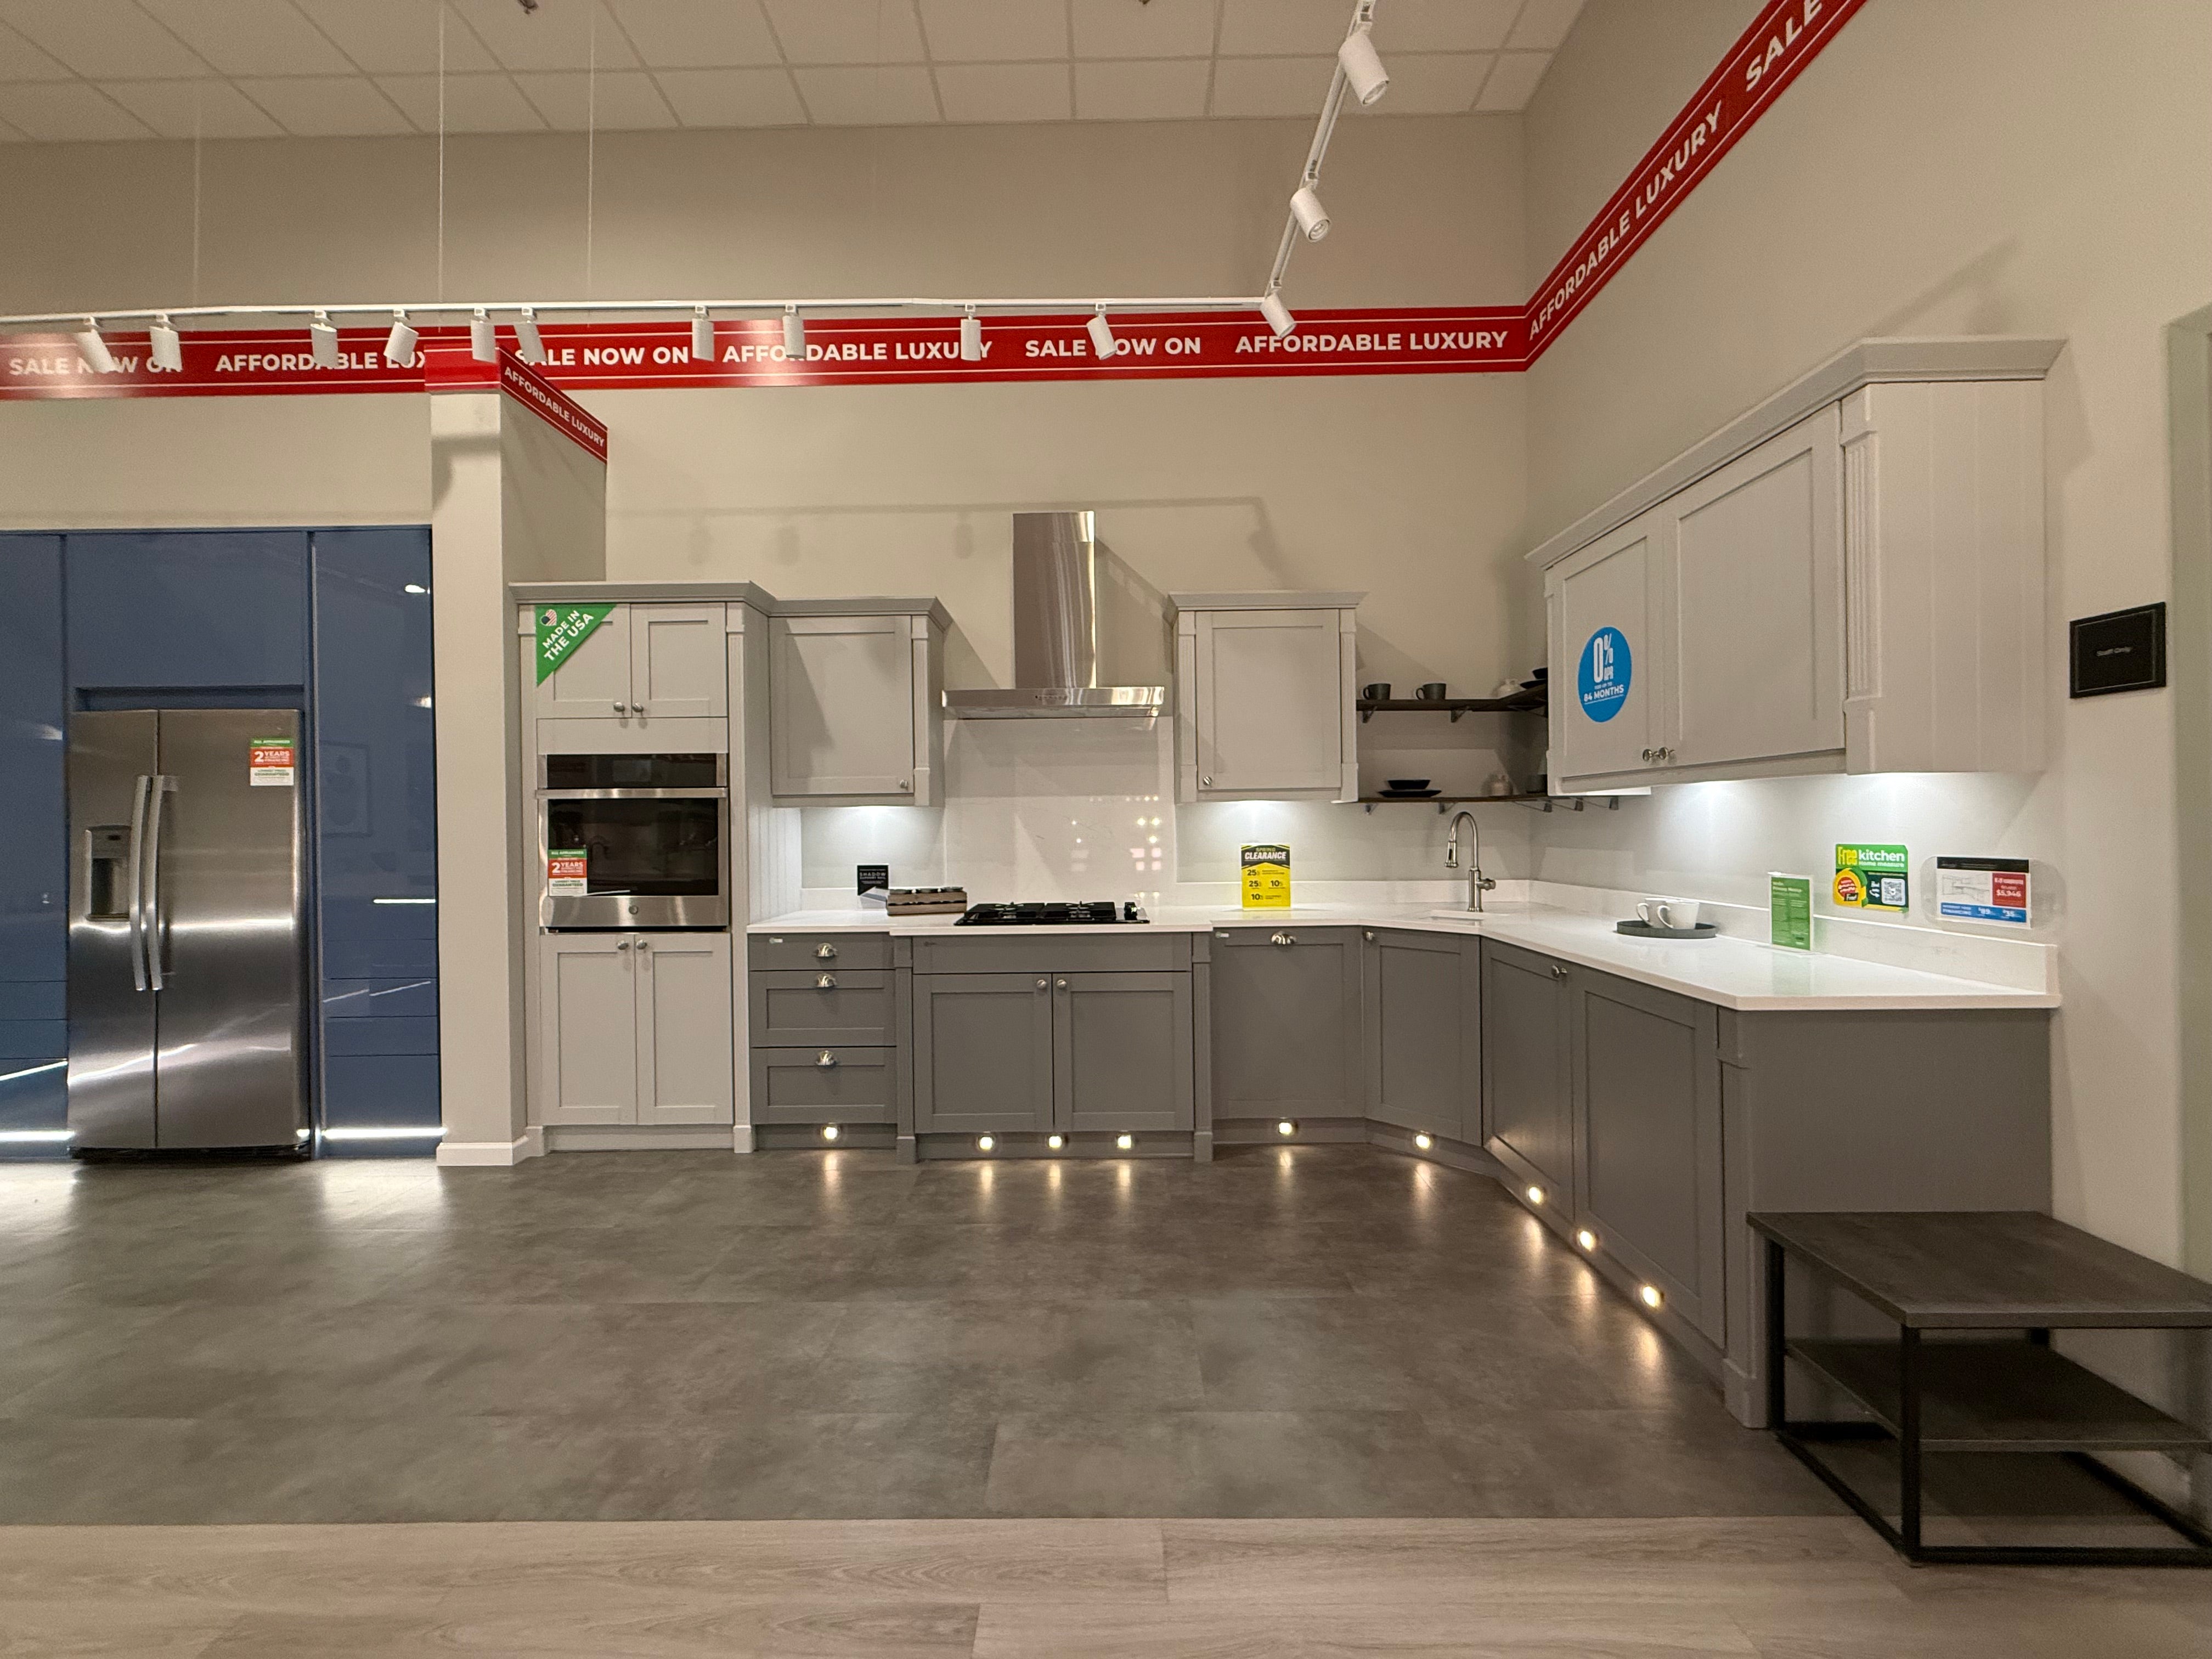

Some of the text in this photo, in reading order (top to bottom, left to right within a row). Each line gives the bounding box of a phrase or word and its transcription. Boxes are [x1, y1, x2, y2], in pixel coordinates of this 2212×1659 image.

[1529, 0, 1824, 340] AFFORDABLE LUXURY SALE
[1025, 337, 1201, 357] SALE OW ON
[1235, 331, 1509, 353] AFFORDABLE LUXURY
[215, 352, 379, 371] AFFORDBLE
[515, 347, 689, 366] SLE NOW ON
[722, 341, 993, 363] AFFODABLE LUXUY
[9, 356, 182, 375] SALE NW O
[504, 366, 605, 447] AFFORDABLE LUXURY
[542, 610, 580, 648] MADE IN
[544, 613, 594, 661] THE USA
[1583, 684, 1624, 702] 84 MONTHS
[254, 751, 264, 763] 2
[1244, 851, 1287, 860] CLEARANCE
[1858, 849, 1905, 862] kitchen
[551, 862, 561, 874] 2
